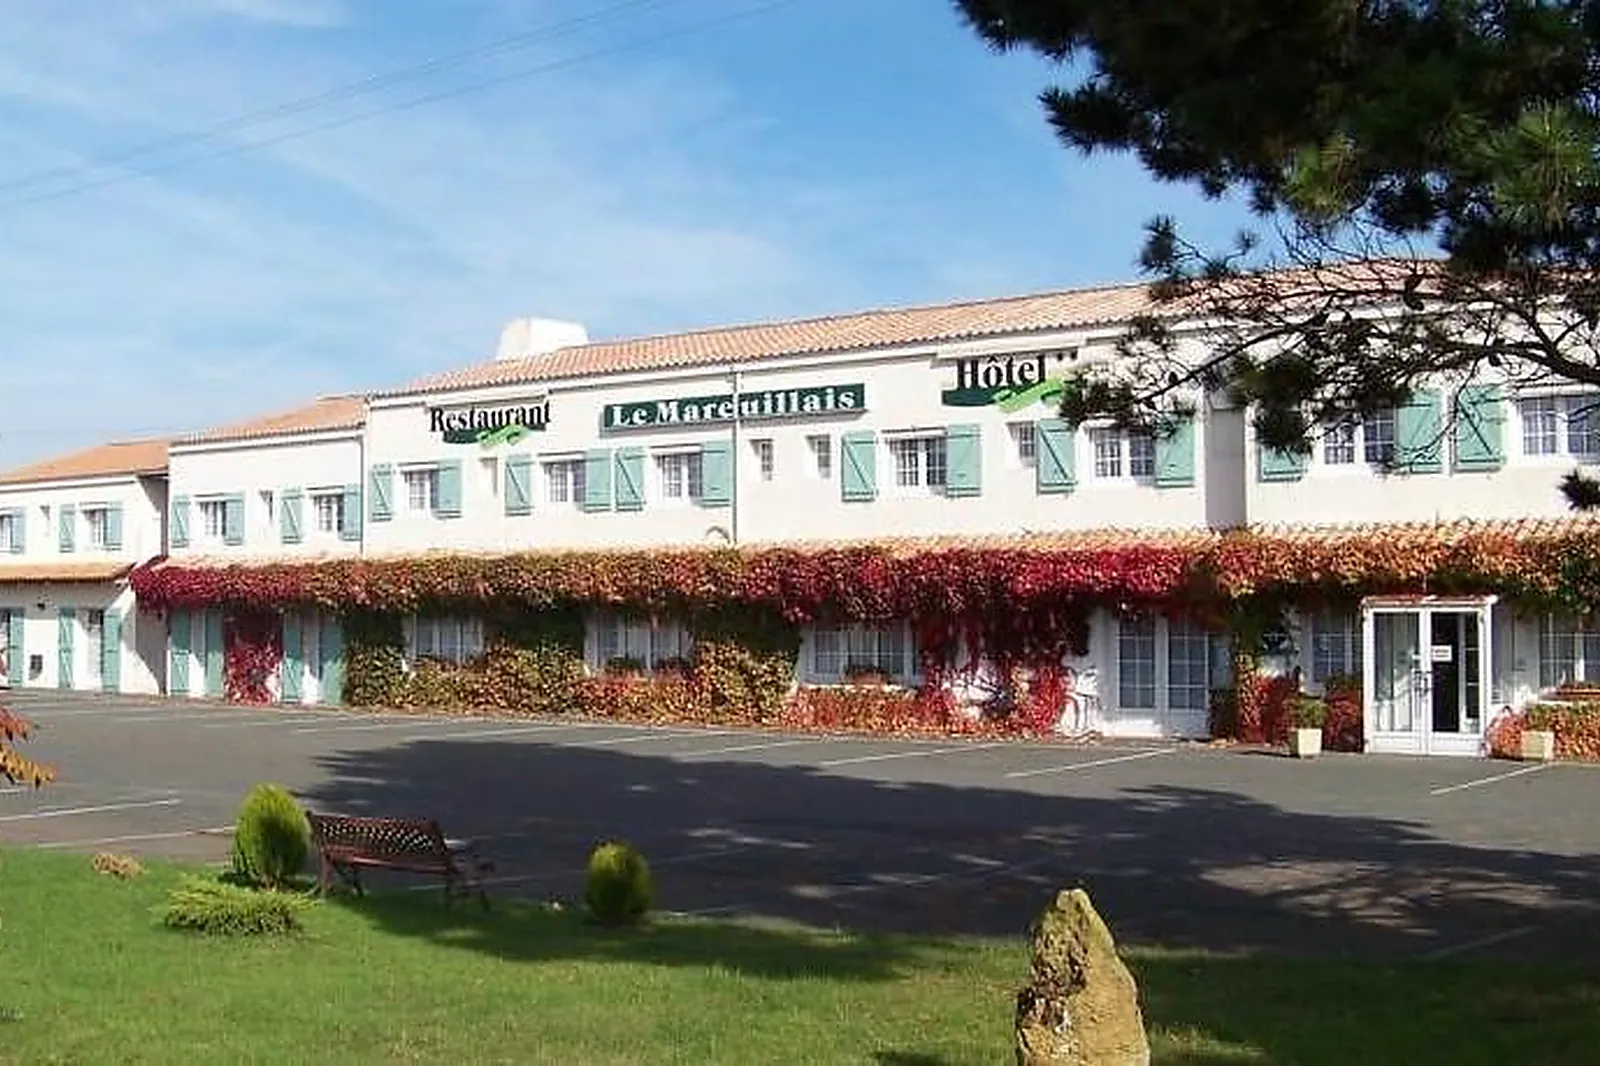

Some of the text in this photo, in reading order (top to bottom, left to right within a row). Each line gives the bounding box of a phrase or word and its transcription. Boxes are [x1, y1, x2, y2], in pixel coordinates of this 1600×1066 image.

[957, 354, 1046, 388] Hôtel
[430, 401, 551, 432] Restaurant
[612, 387, 855, 427] Le Mareuillais
